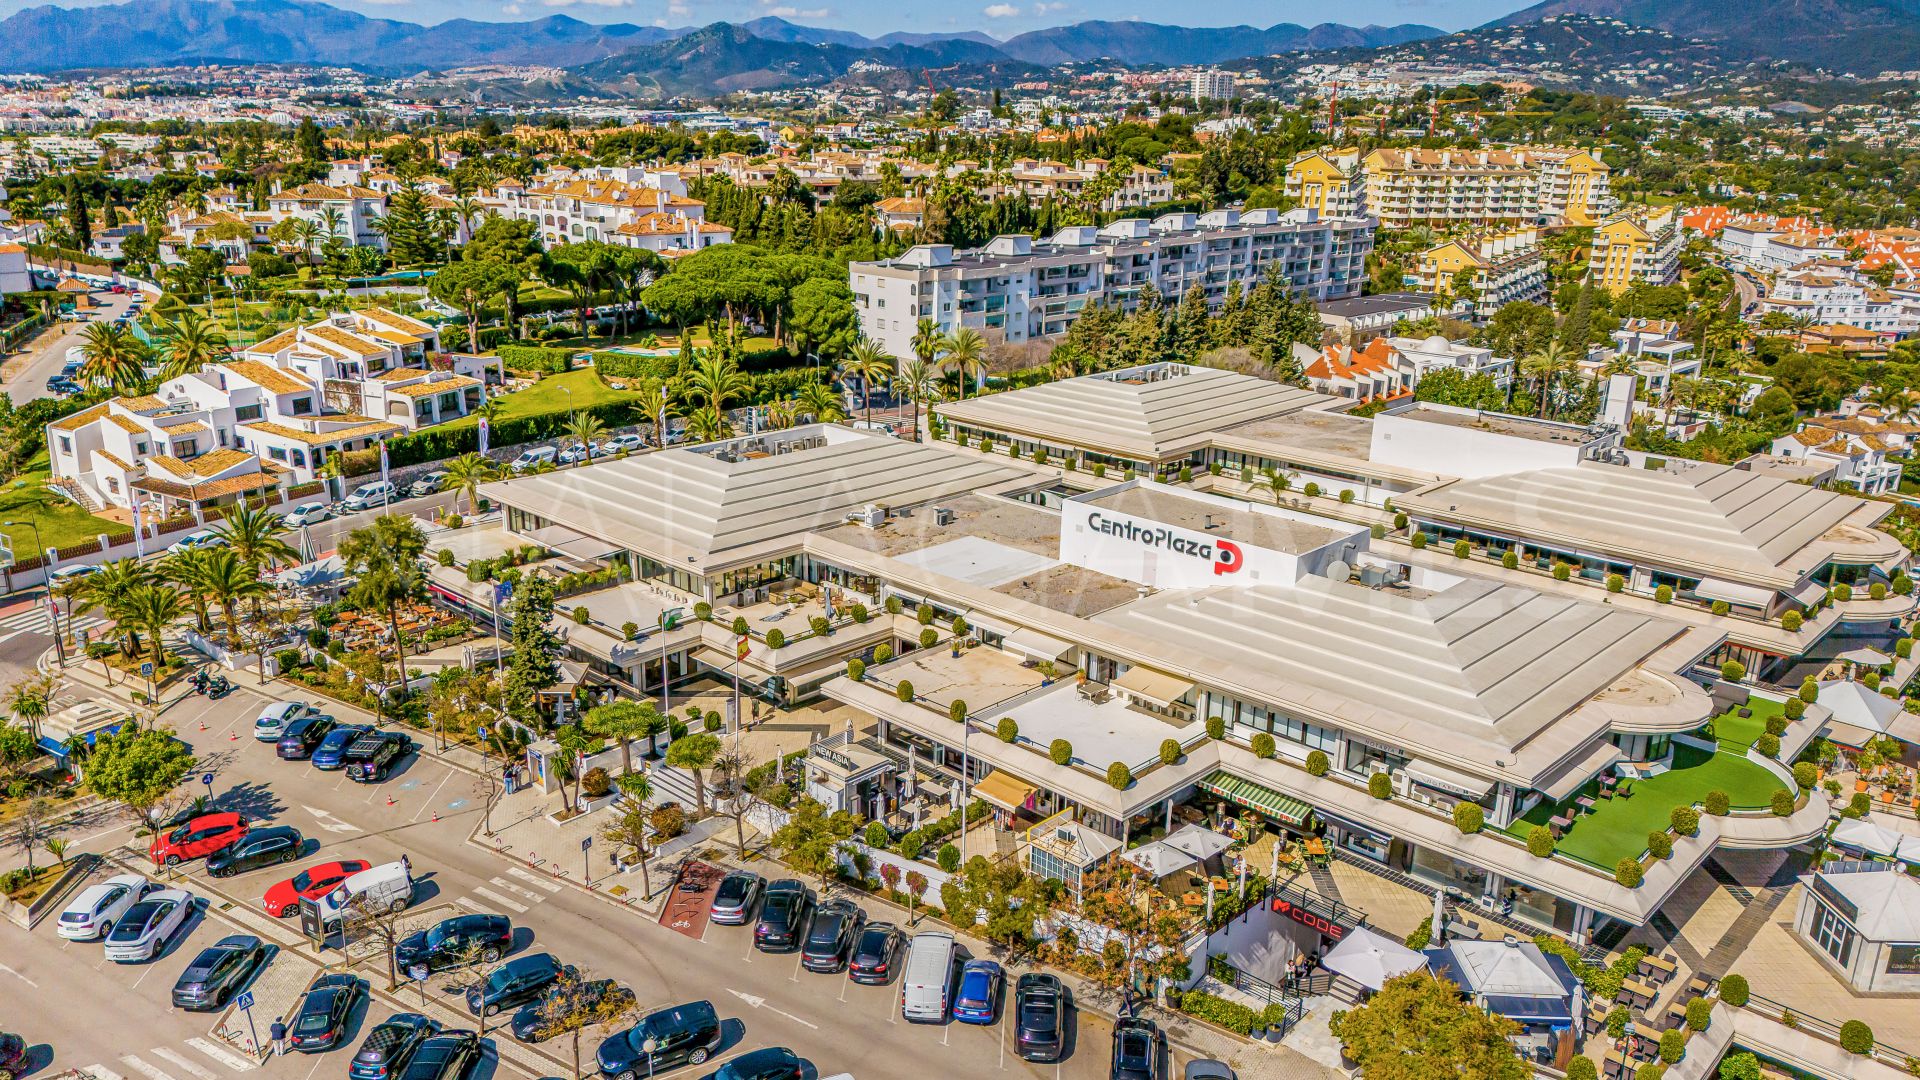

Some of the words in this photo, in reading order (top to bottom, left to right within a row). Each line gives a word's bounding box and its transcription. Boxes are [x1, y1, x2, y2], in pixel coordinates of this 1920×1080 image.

[1088, 512, 1212, 560] CentroPlaza
[815, 744, 832, 760] NEW
[832, 752, 849, 766] ASIA
[1292, 908, 1342, 938] CODE
